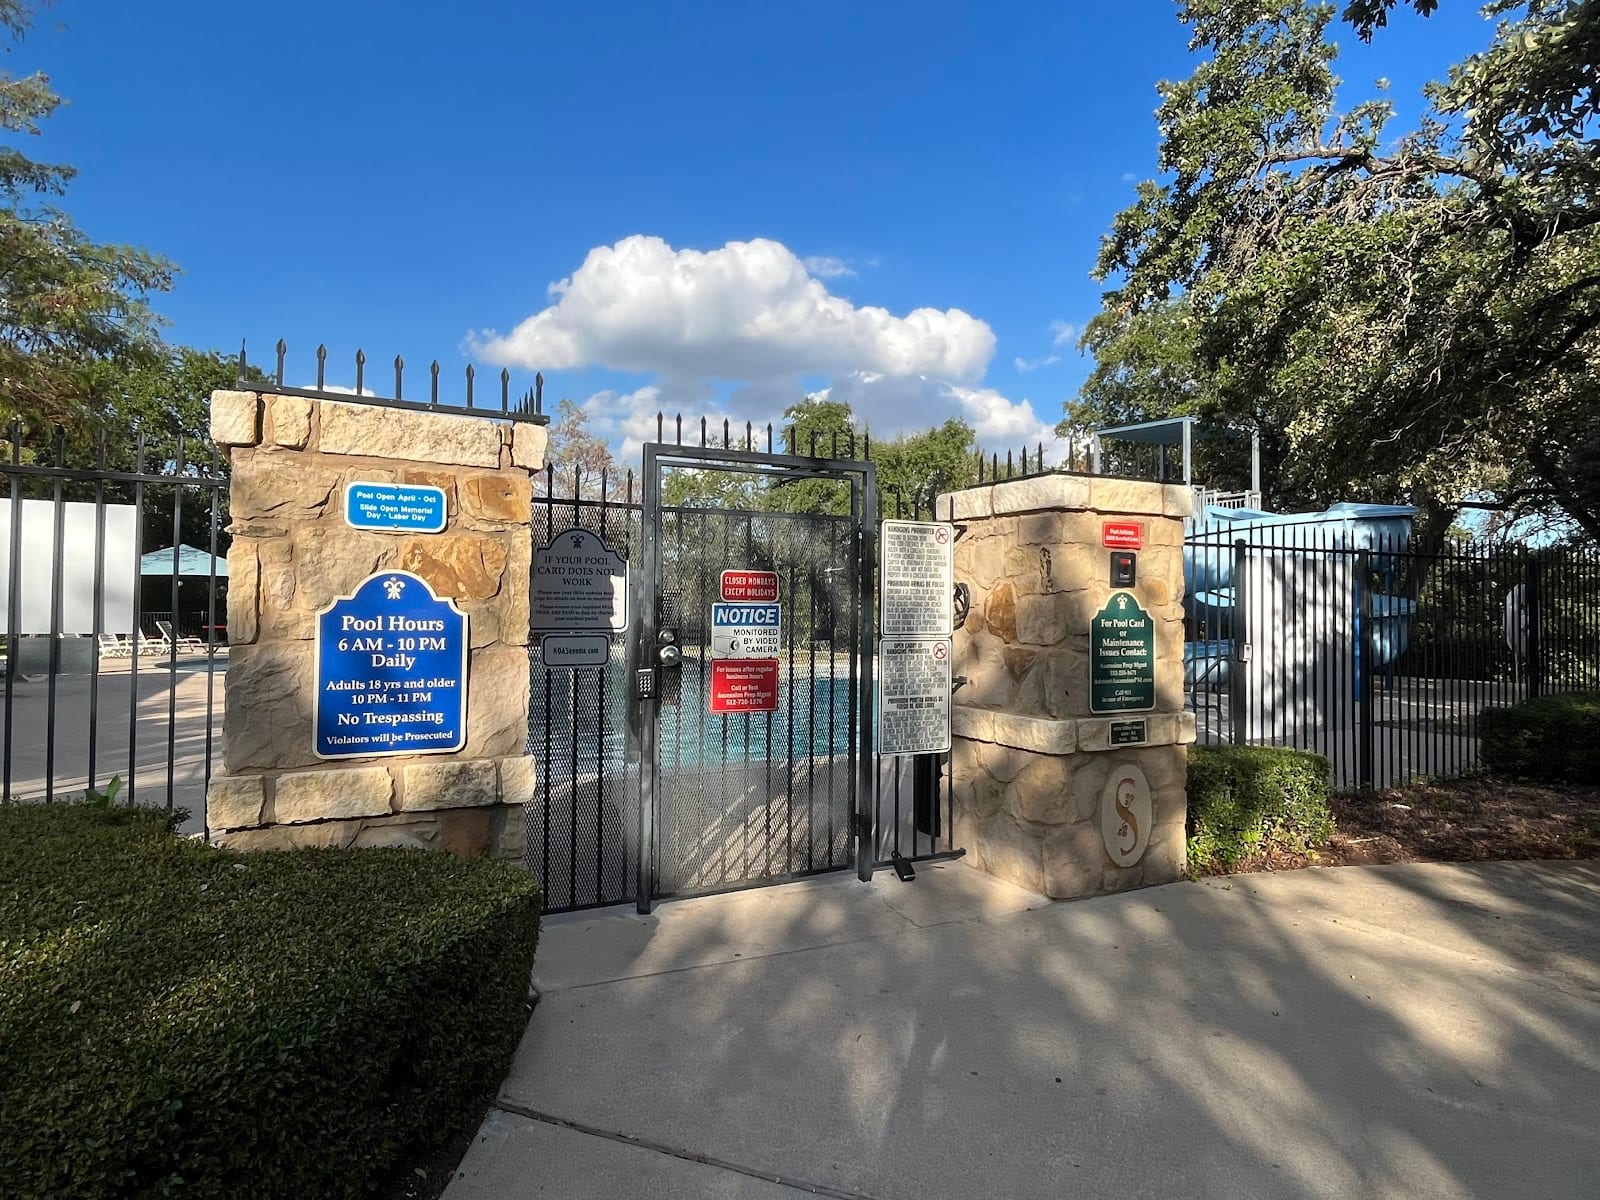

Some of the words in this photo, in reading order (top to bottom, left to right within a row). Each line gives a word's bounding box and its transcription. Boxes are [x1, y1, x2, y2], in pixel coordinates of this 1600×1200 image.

[357, 491, 373, 499] Pool
[376, 493, 395, 501] Open
[398, 494, 416, 502] April
[401, 506, 433, 514] Memorial
[412, 514, 426, 522] Day
[545, 556, 553, 564] IF
[556, 556, 582, 564] YOUR
[585, 557, 610, 565] POOL
[538, 567, 566, 575] CARD
[562, 578, 592, 586] WORK
[725, 577, 746, 585] CLOSED
[748, 577, 775, 586] MONDAYS
[725, 588, 746, 596] EXCEPT
[717, 609, 777, 624] NOTICE
[342, 616, 383, 631] Pool
[388, 616, 445, 631] Hours
[1101, 619, 1112, 628] For
[1113, 619, 1128, 628] Pool
[1129, 619, 1145, 628] Card
[338, 638, 348, 651] 6
[351, 638, 383, 651] AM
[398, 638, 415, 650] 10
[419, 638, 446, 650] PM
[1103, 638, 1144, 647] Maintenance
[1100, 648, 1120, 657] Issues
[1121, 648, 1147, 656] Contact:
[372, 654, 416, 671] Daily
[326, 680, 366, 691] Adults
[369, 680, 381, 690] 18
[383, 681, 401, 692] yrs
[404, 679, 424, 688] and
[427, 678, 456, 688] older
[352, 695, 364, 704] 10
[367, 694, 387, 704] PM
[398, 694, 408, 702] 11
[412, 692, 432, 702] PM
[338, 713, 359, 725] No
[363, 710, 444, 726] Trespassing
[327, 736, 369, 745] Violators
[371, 734, 390, 742] will
[392, 733, 402, 742] be
[405, 731, 453, 741] Prosecuted
